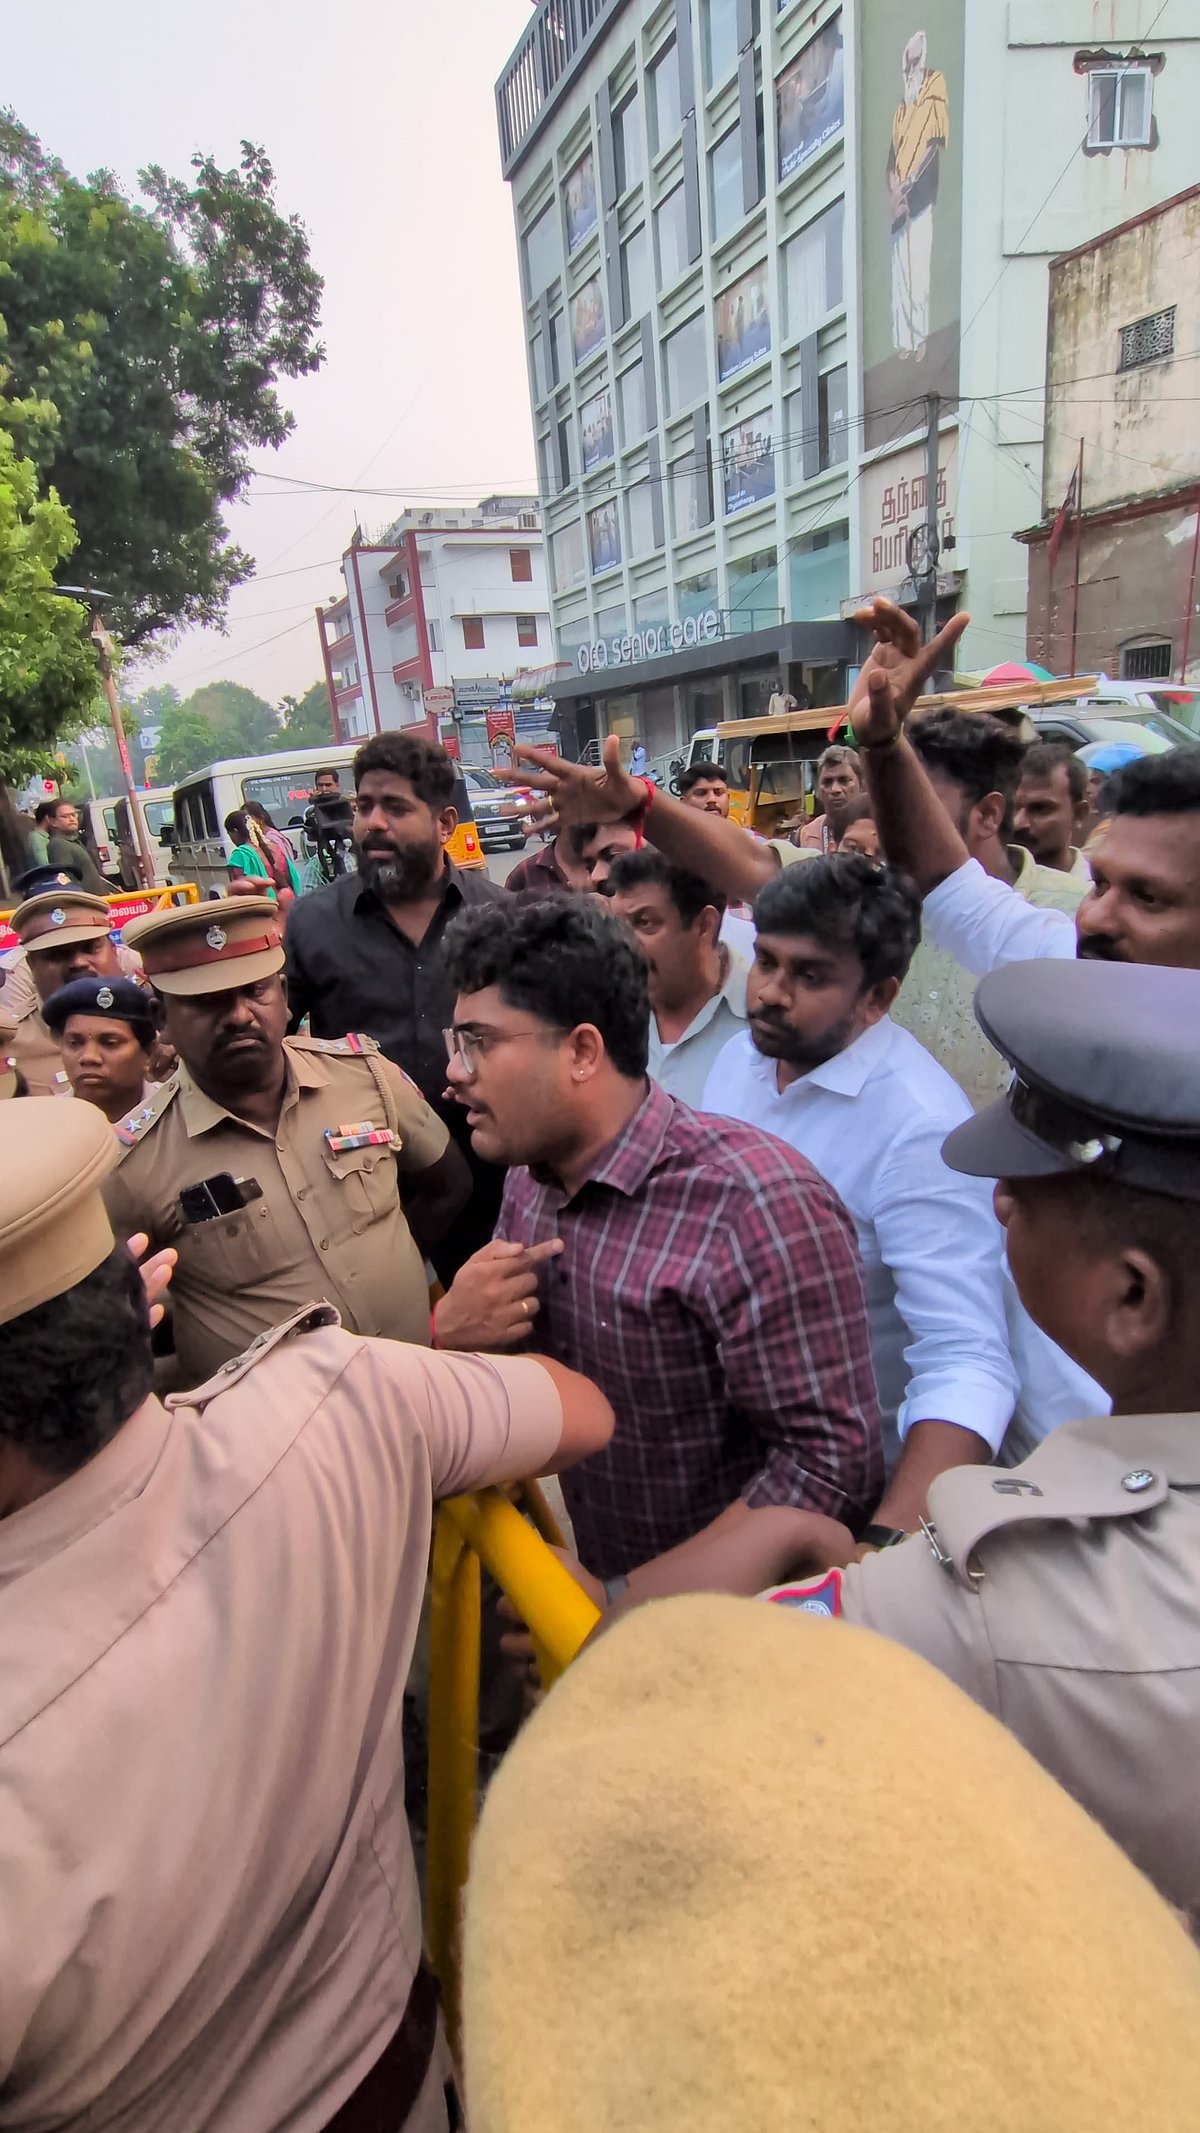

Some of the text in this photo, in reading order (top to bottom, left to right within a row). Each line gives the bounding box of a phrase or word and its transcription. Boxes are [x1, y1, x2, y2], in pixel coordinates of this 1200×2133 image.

[822, 119, 841, 139] Clinics
[612, 624, 664, 664] senior
[670, 610, 718, 648] care
[107, 901, 148, 918] லையம்
